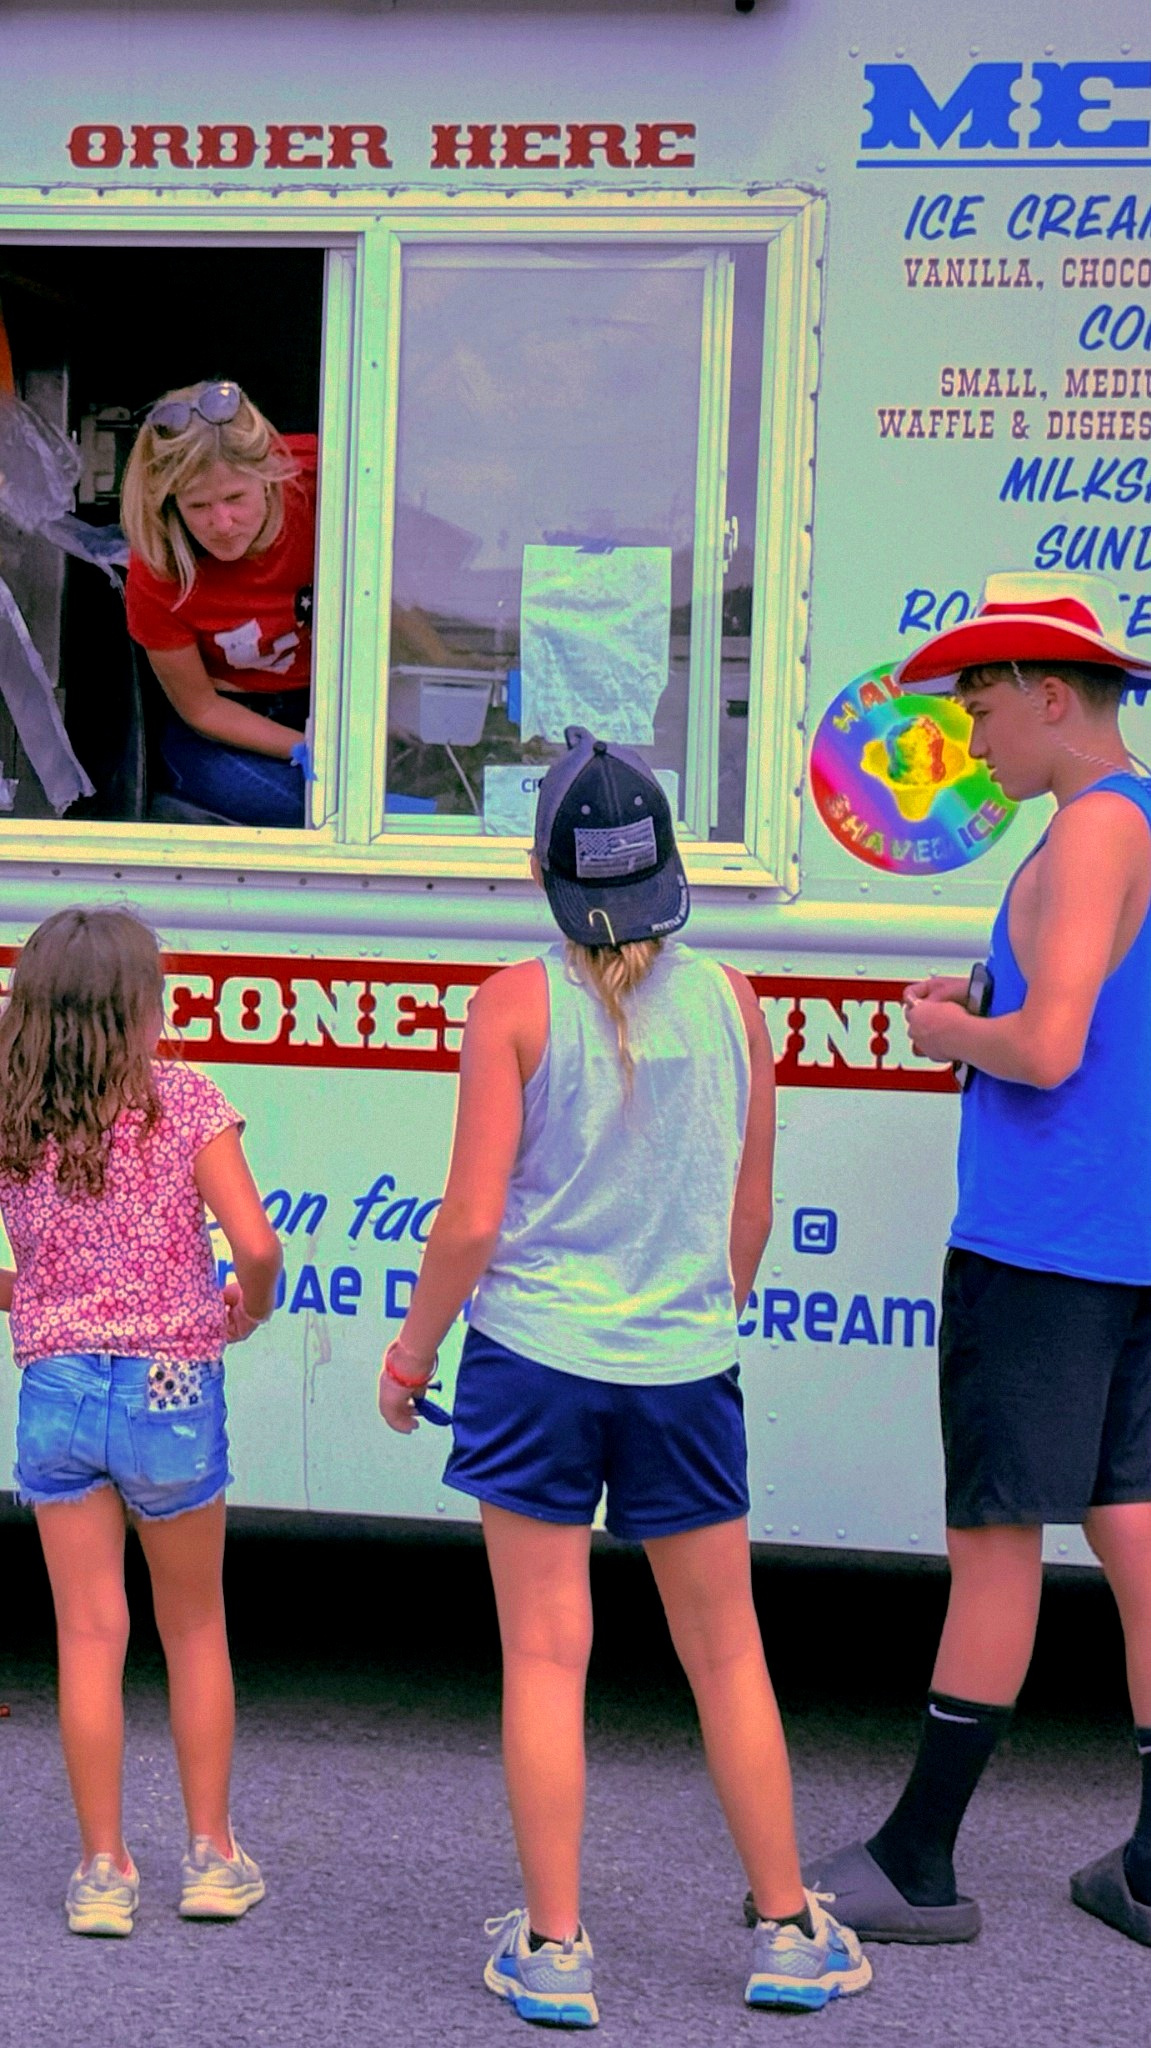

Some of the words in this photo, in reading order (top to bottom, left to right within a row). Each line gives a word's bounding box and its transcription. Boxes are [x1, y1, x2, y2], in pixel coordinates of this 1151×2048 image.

[66, 123, 393, 170] ORDER
[430, 123, 697, 169] HERE
[904, 193, 985, 241] ICE
[904, 257, 1044, 291] VANILLA,
[1078, 303, 1151, 351] CO
[941, 367, 1048, 400] SMALL,
[877, 409, 994, 440] WAFFLE
[1011, 410, 1030, 440] &
[999, 456, 1151, 503] MILKS
[957, 798, 1009, 849] ICE
